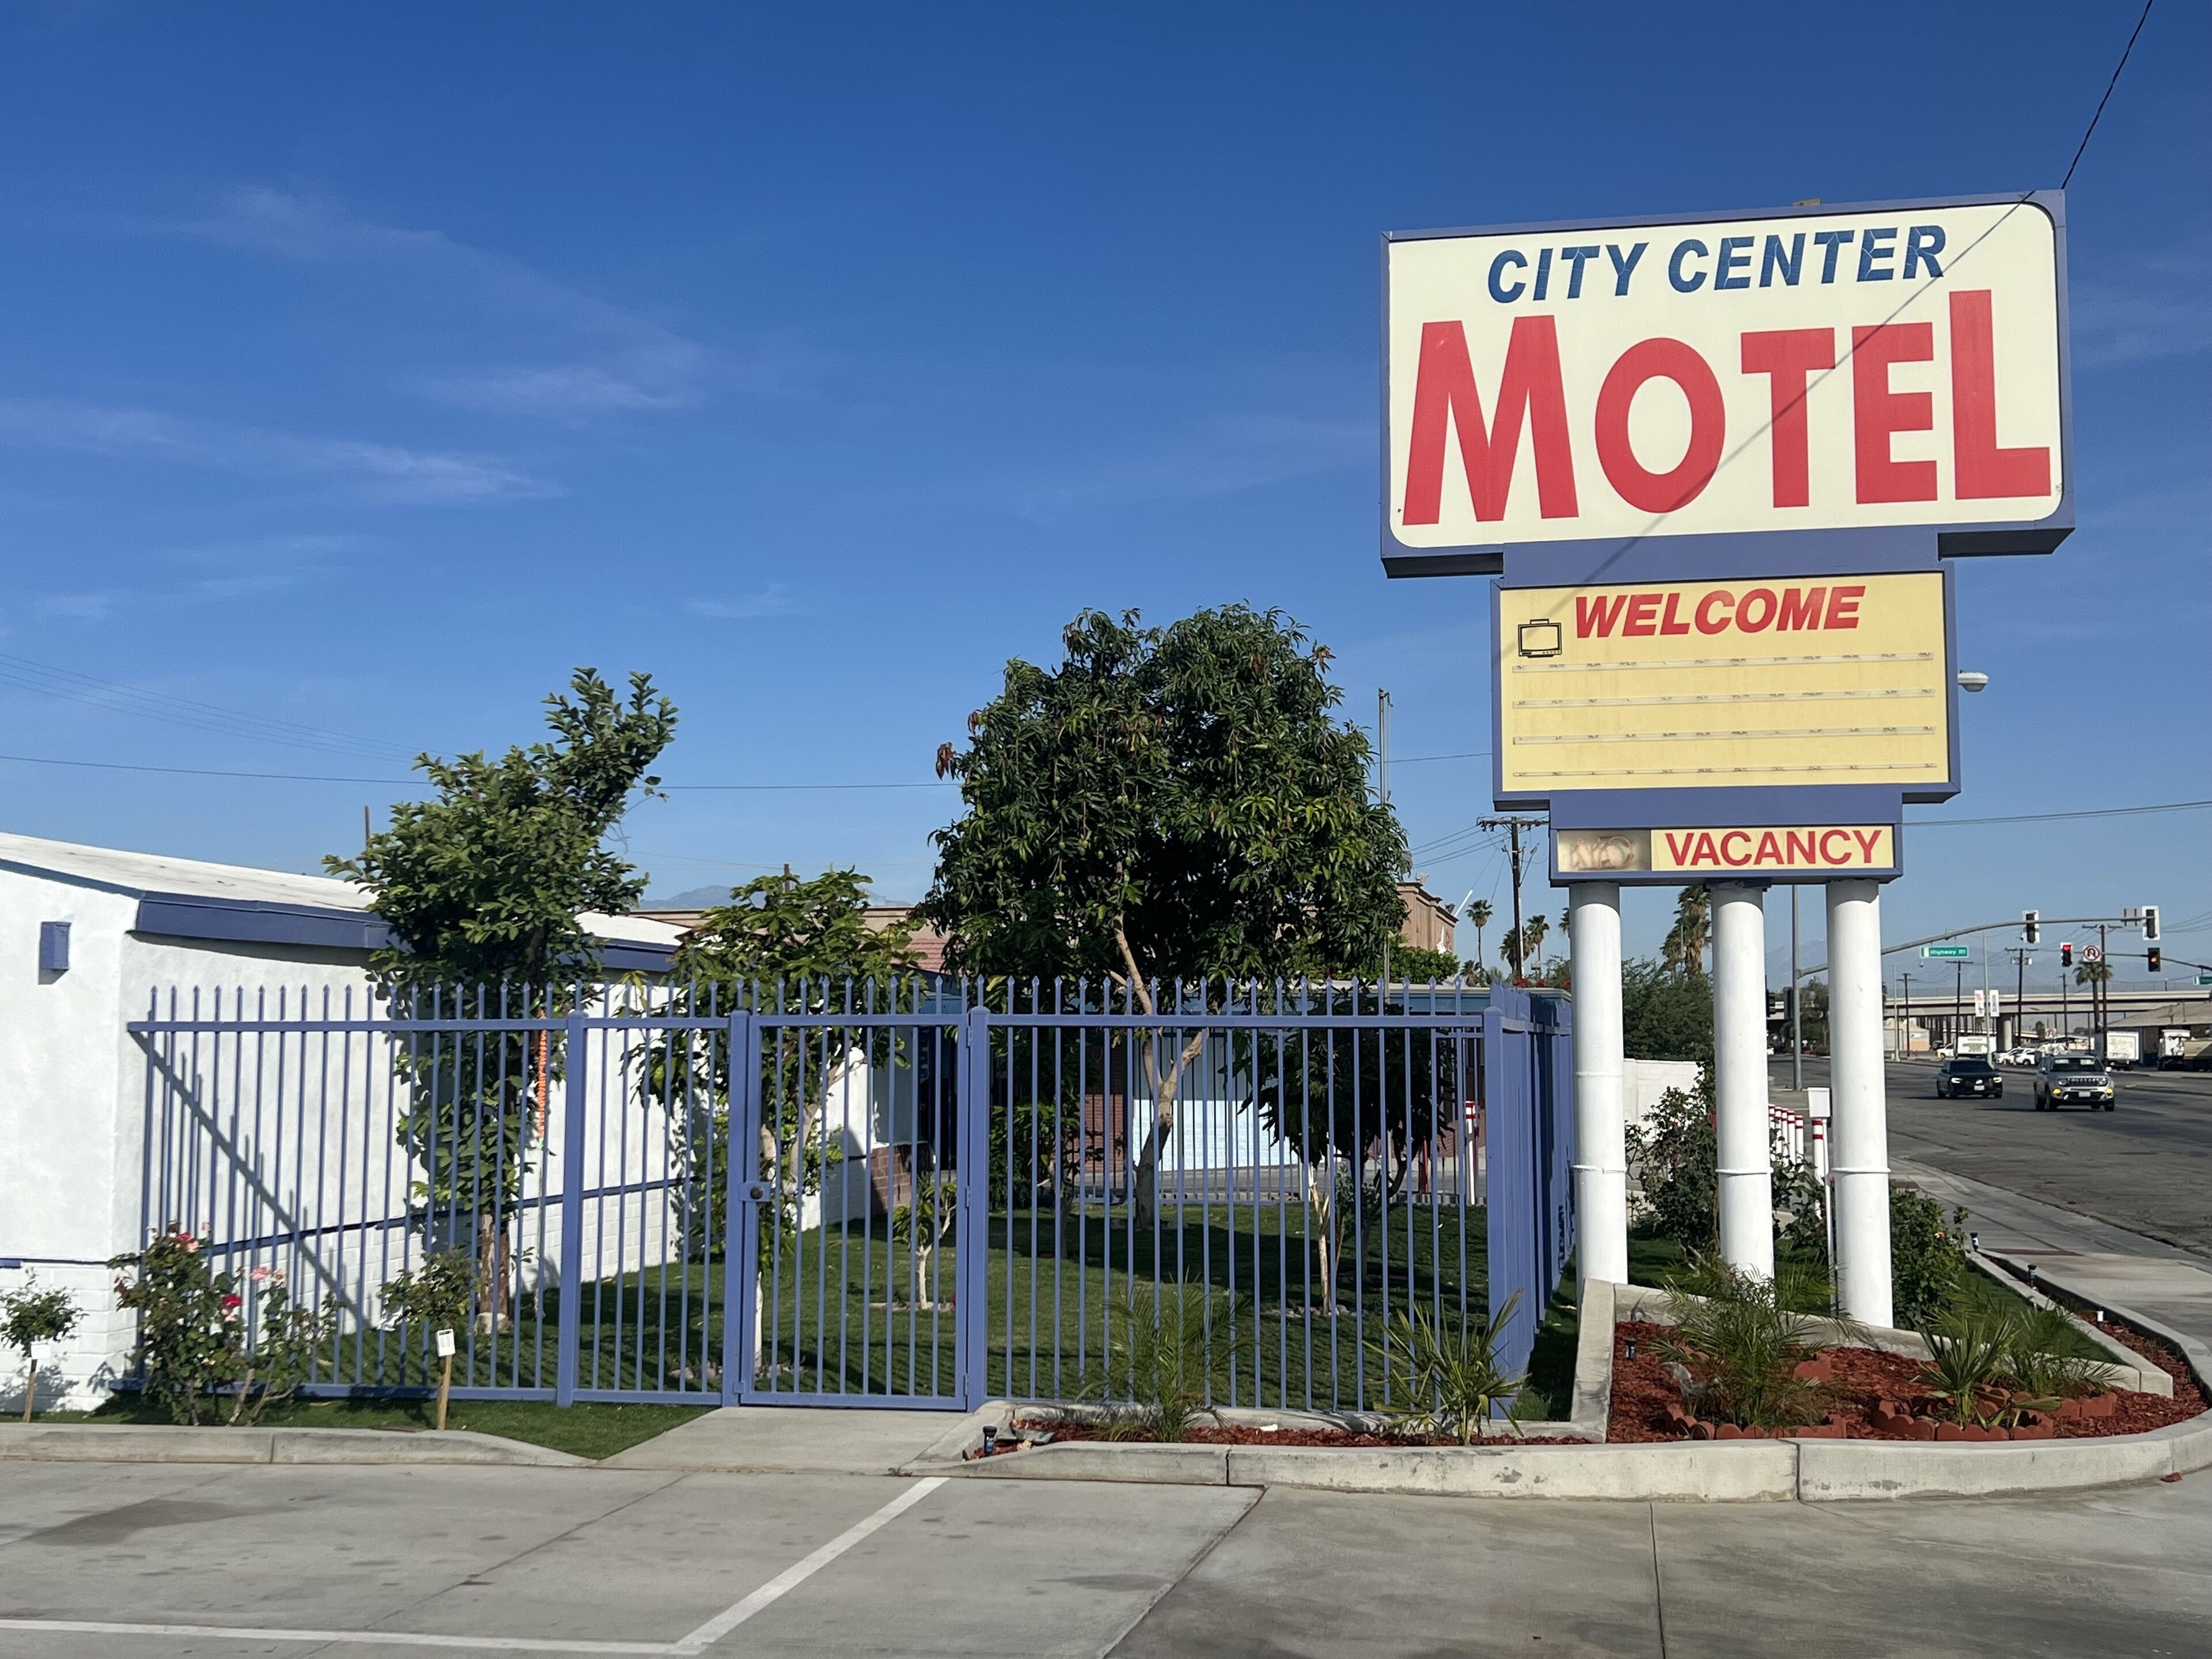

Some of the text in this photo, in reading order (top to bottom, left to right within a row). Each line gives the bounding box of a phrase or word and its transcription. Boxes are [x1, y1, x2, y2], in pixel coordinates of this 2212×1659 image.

[1488, 225, 1945, 302] CITY CENTER
[1403, 290, 2051, 525] MOTEL
[1576, 586, 1865, 638] WELCOME
[1574, 830, 1882, 870] NO VACANCY
